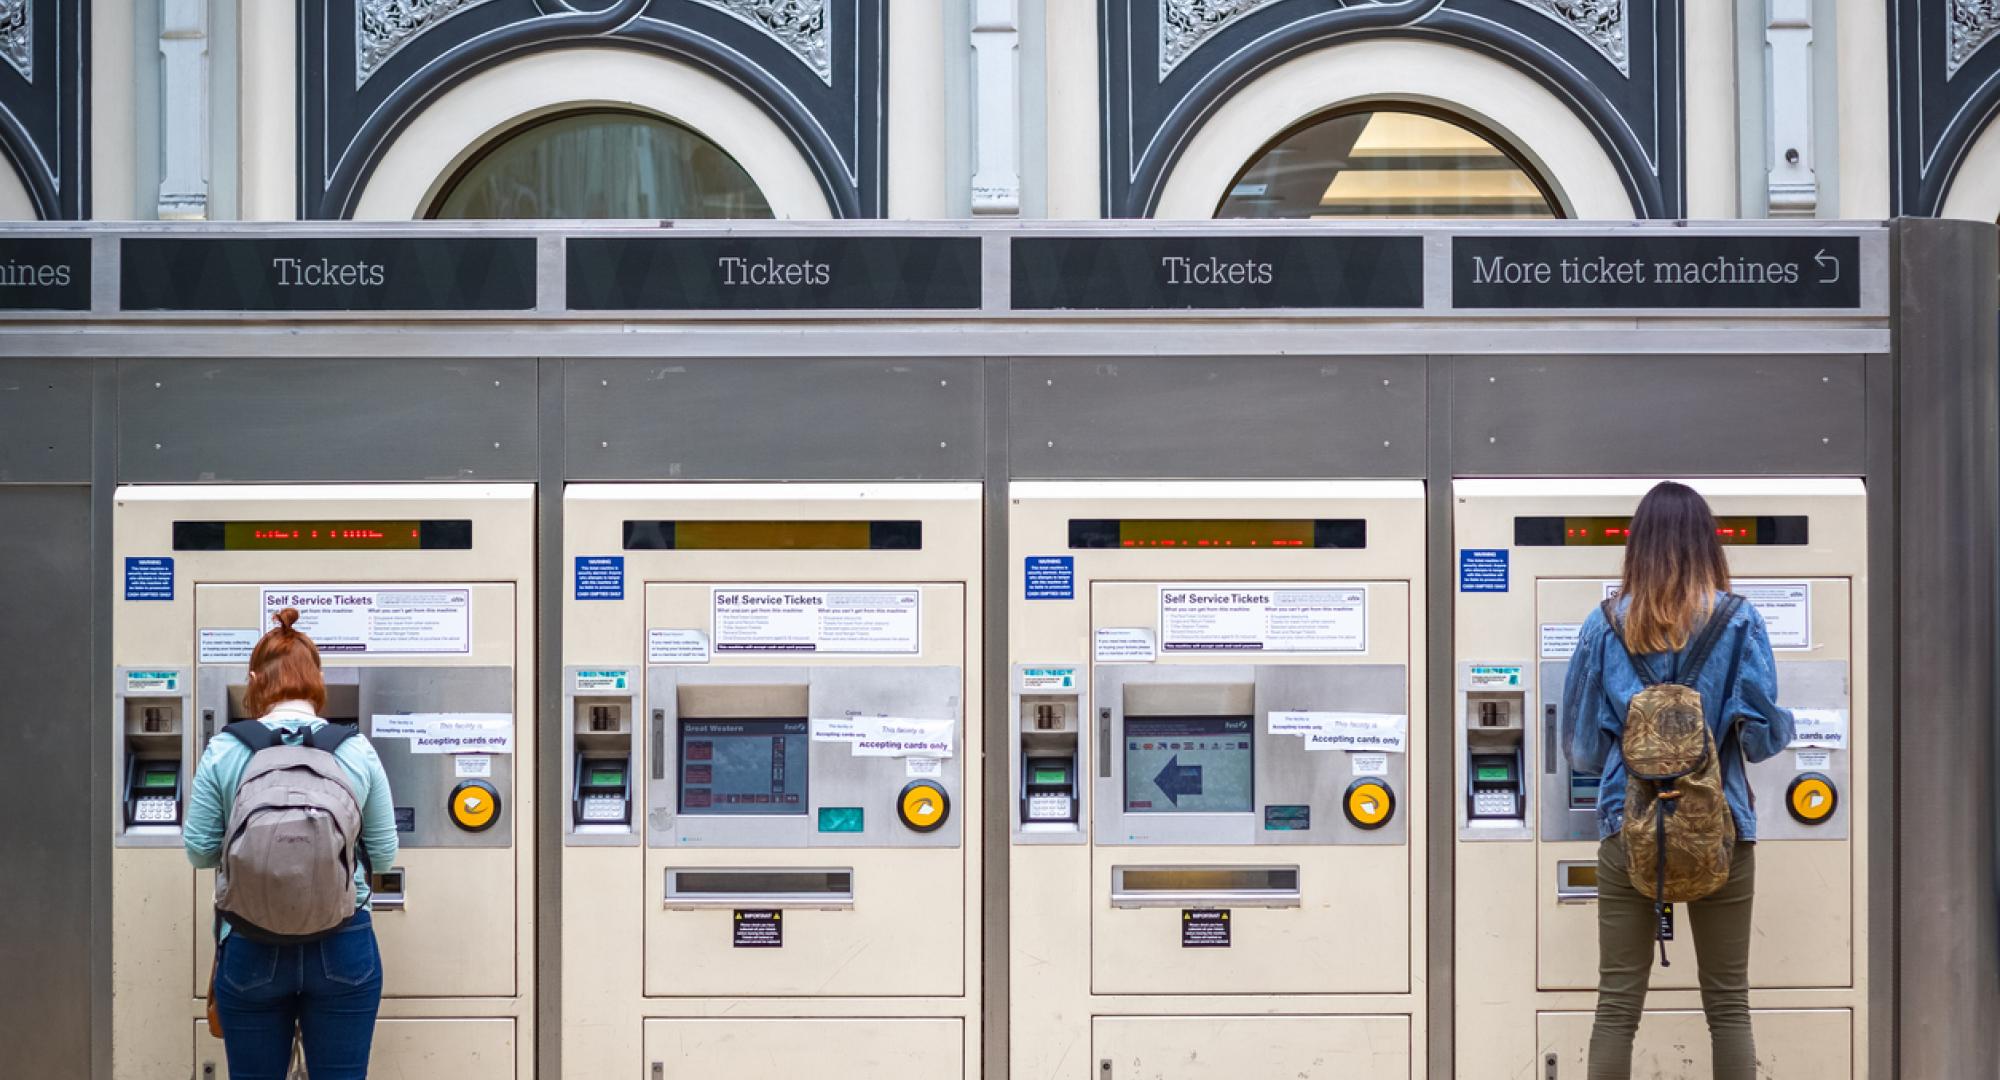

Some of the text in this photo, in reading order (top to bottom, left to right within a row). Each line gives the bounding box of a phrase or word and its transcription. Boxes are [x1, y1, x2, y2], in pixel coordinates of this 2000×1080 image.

[273, 258, 384, 286] Tickets
[718, 256, 830, 285] Tickets
[1162, 256, 1273, 285] Tickets
[1472, 255, 1799, 284] More ticket machines
[267, 594, 289, 606] Self
[291, 594, 333, 606] Service
[334, 594, 373, 606] Tickets
[717, 594, 739, 606] Self
[742, 594, 783, 606] Service
[784, 594, 823, 606] Tickets
[1165, 593, 1186, 605] Self
[1189, 593, 1229, 605] Service
[1231, 593, 1270, 605] Tickets
[685, 724, 708, 732] Great
[417, 736, 508, 747] Accepting cards only
[1312, 734, 1400, 746] Accepting cards only
[1799, 732, 1824, 740] cards
[1824, 732, 1842, 742] only
[859, 741, 948, 751] Accepting cards only
